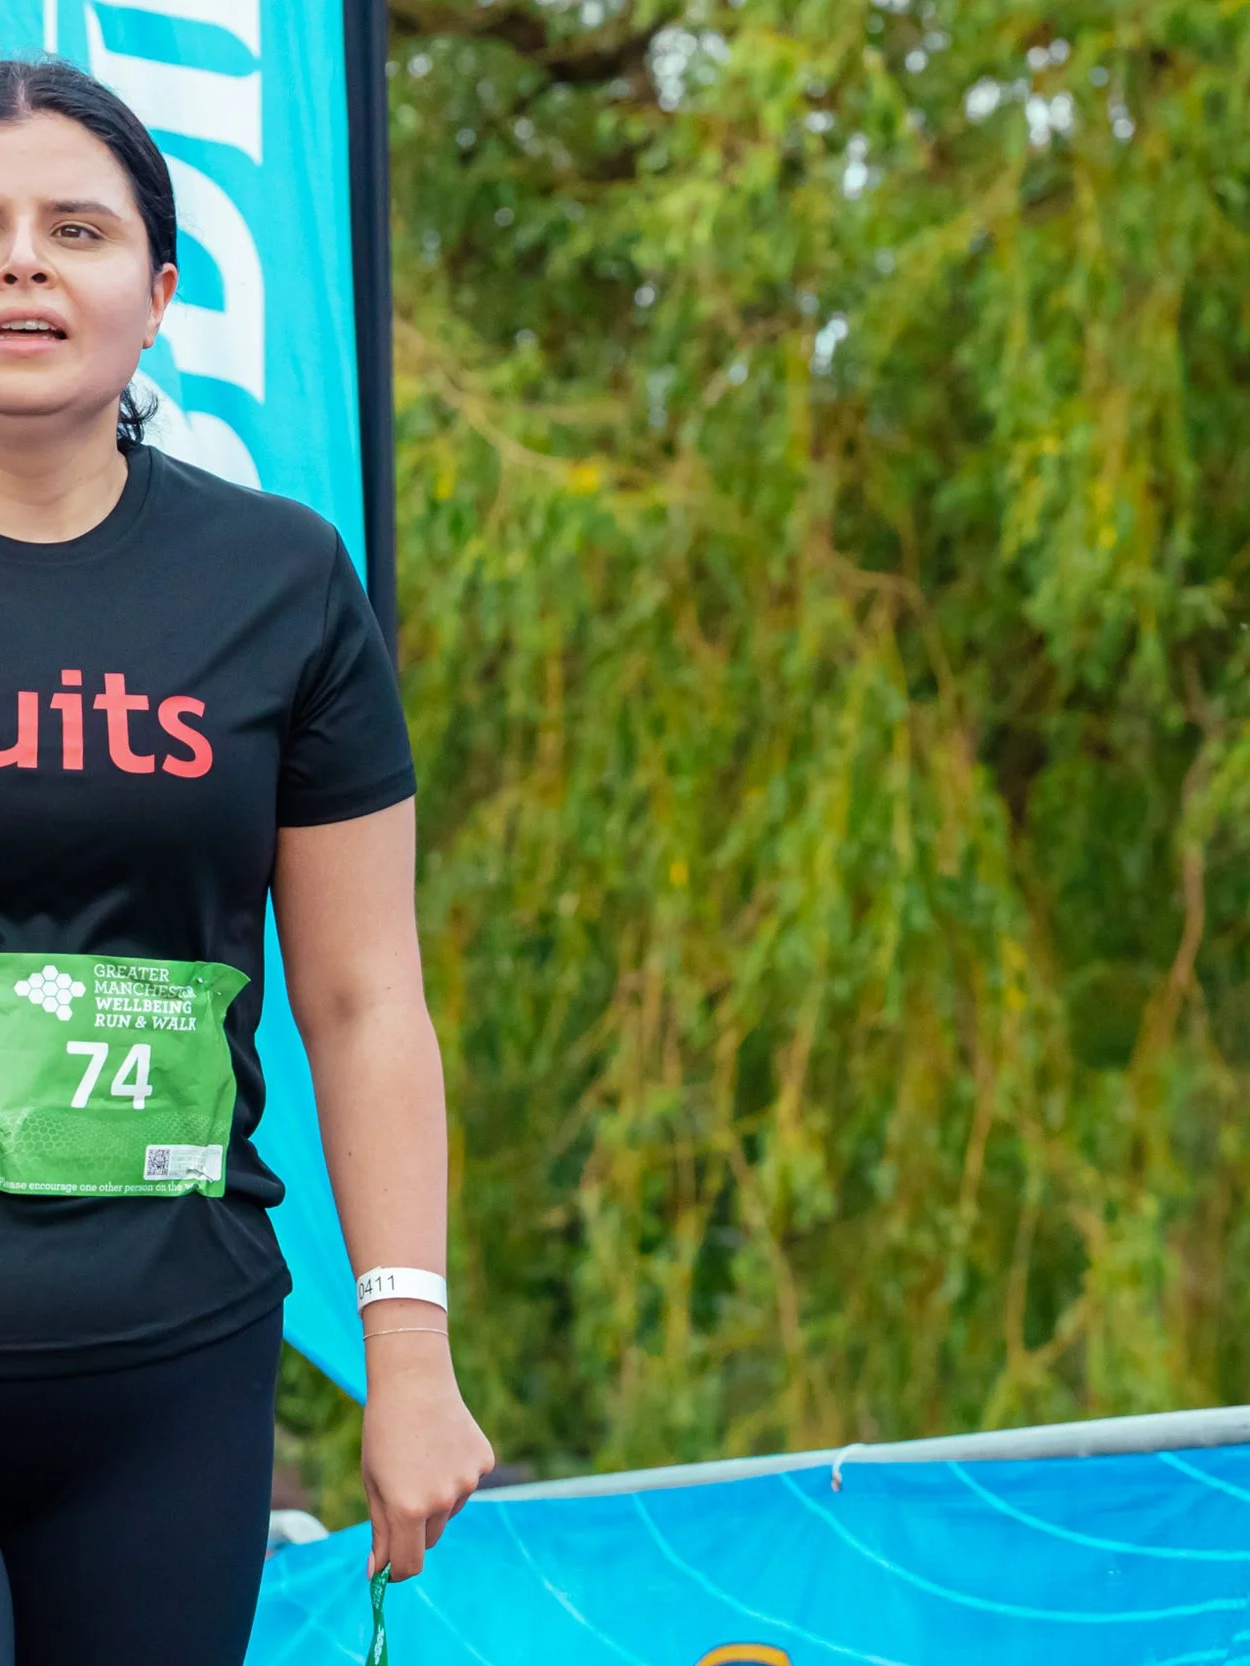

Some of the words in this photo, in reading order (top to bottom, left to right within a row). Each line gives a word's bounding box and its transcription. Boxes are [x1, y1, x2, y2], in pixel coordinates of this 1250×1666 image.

[94, 963, 170, 982] GREATER
[95, 997, 192, 1014] WELLBEING
[94, 1013, 132, 1028] RUN
[135, 1015, 147, 1029] &
[152, 1016, 196, 1031] WALK
[66, 1040, 153, 1110] 74
[29, 1180, 78, 1193] encourage
[79, 1183, 97, 1192] one
[98, 1181, 123, 1192] other
[124, 1183, 153, 1194] person
[155, 1184, 166, 1192] on
[168, 1181, 183, 1192] the
[358, 1274, 395, 1300] 0411
